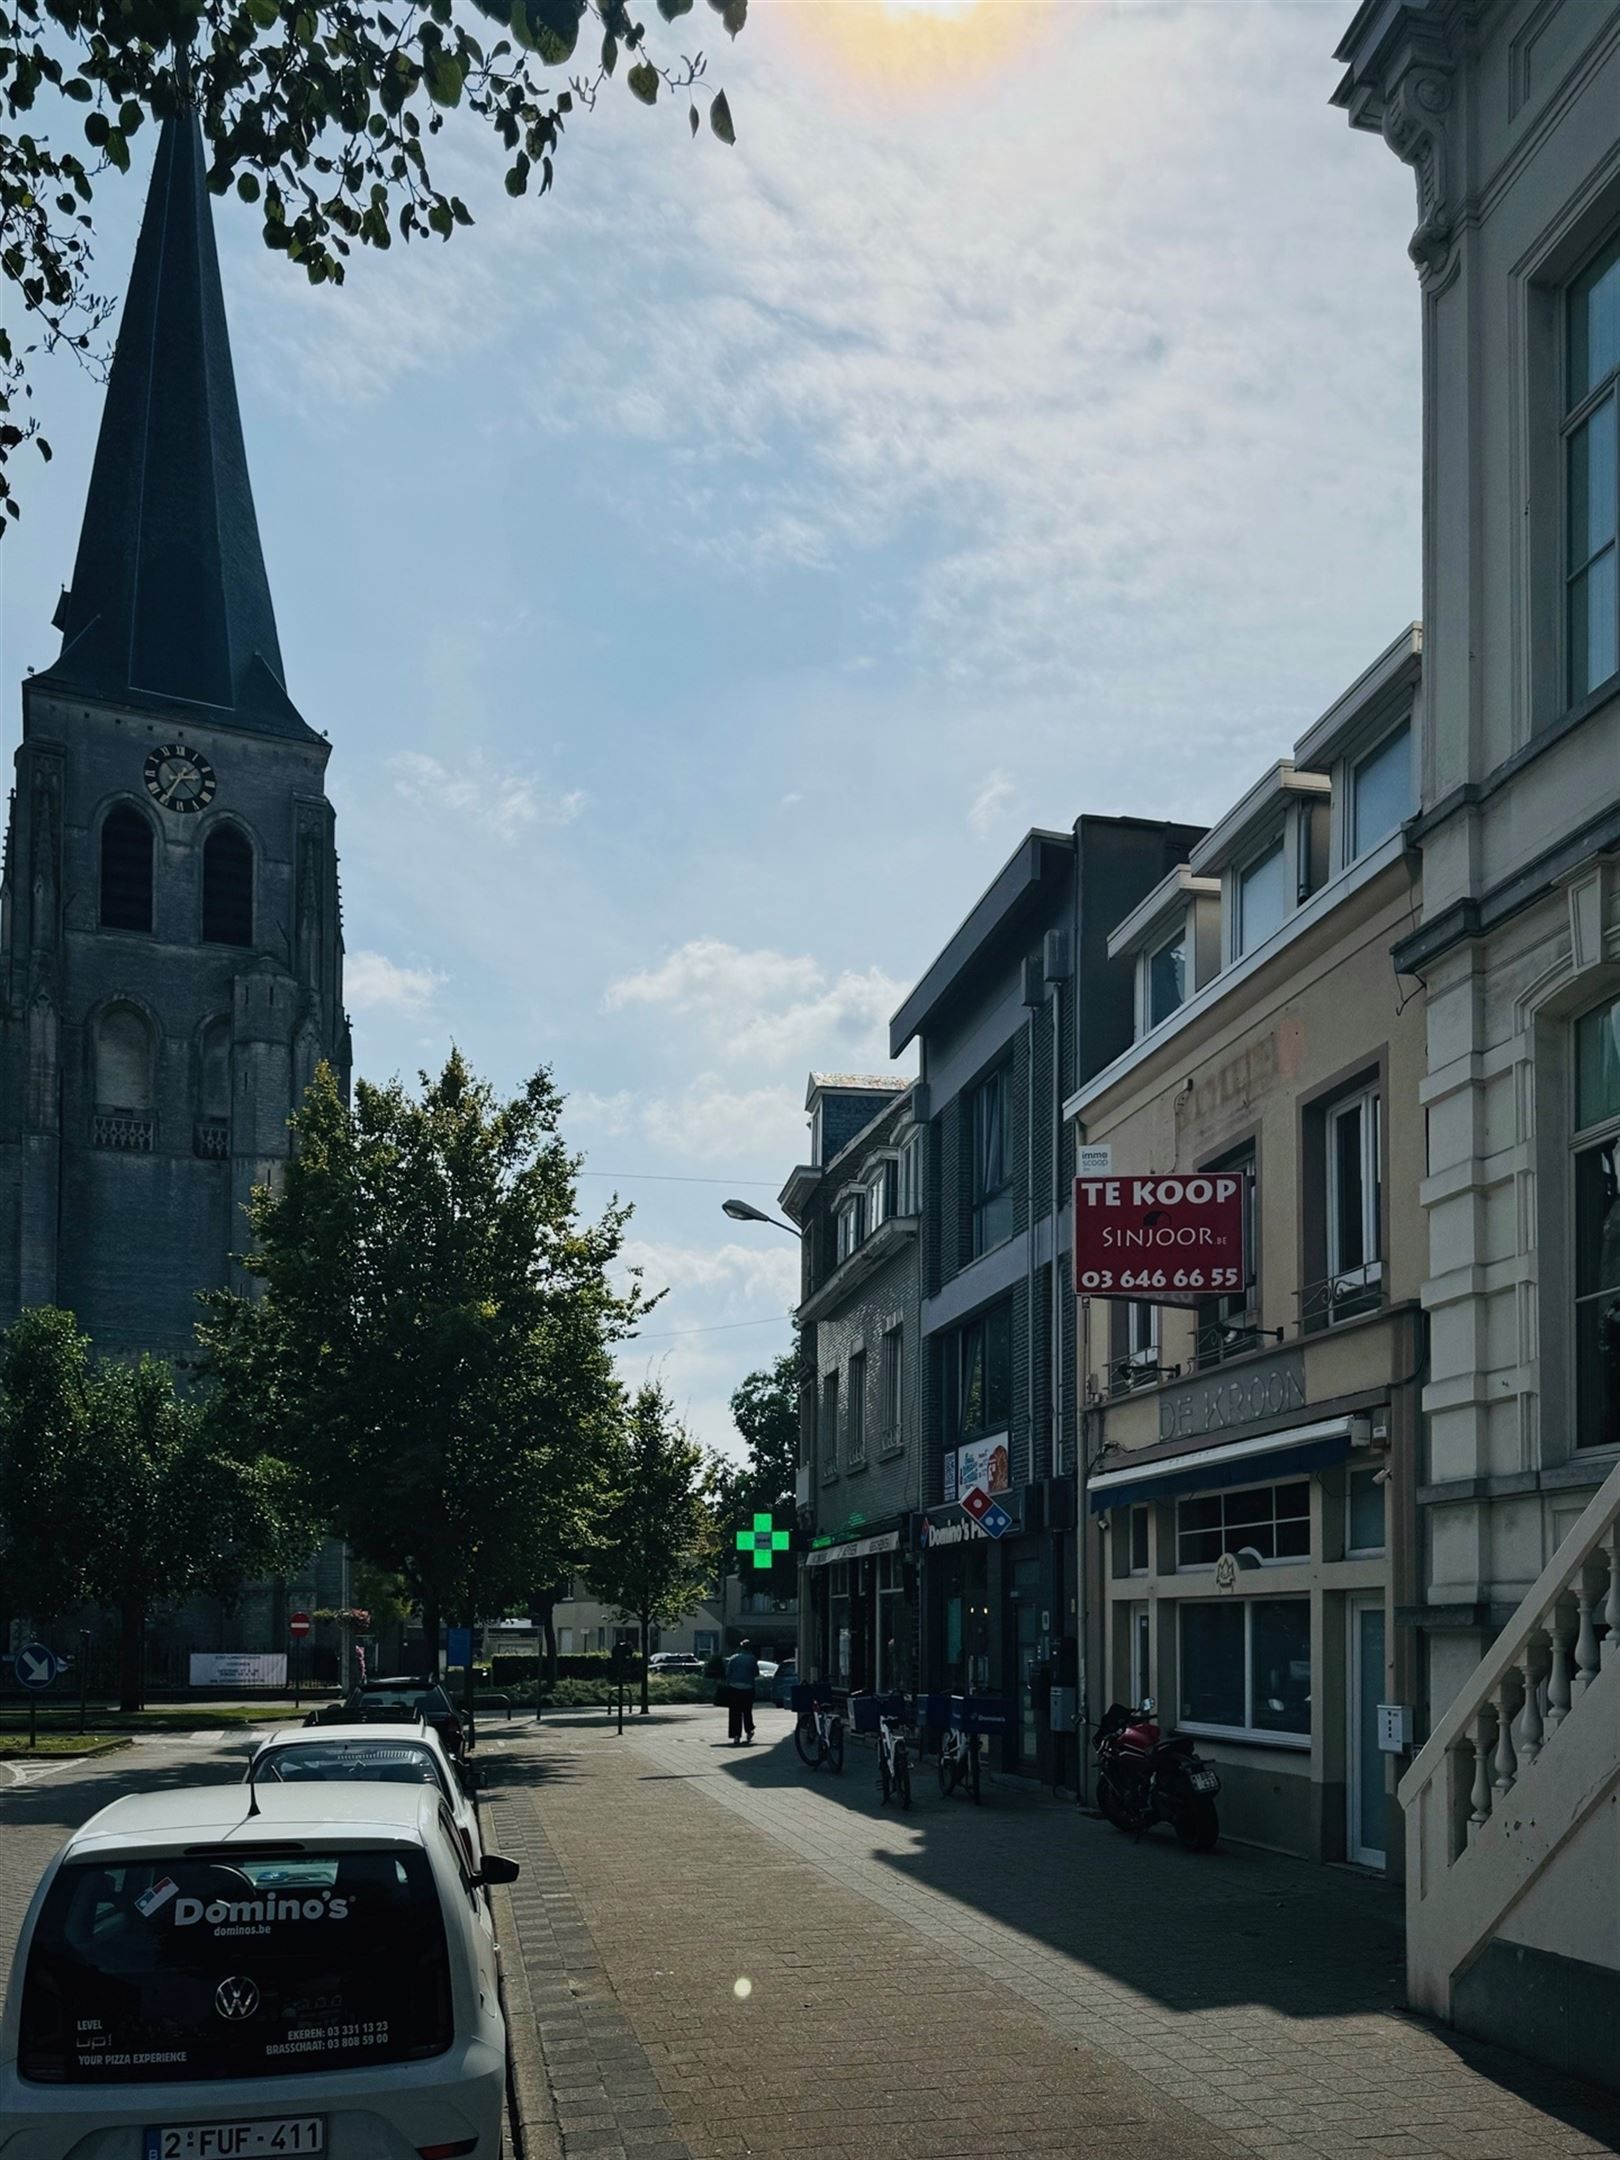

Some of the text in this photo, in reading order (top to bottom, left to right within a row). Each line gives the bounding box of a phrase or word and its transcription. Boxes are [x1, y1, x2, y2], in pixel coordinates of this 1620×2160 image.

[1082, 1151, 1108, 1160] immo
[1082, 1160, 1109, 1168] scoop
[1081, 1179, 1237, 1206] TE KOOP
[1081, 1268, 1238, 1288] 03 646 66 55
[1160, 1370, 1306, 1442] DE KROON
[929, 1517, 970, 1548] Domino's
[214, 1925, 271, 1936] dominos.be
[77, 2020, 102, 2031] LEVEL
[288, 2021, 389, 2041] EKEREN: 03 331 13 23
[266, 2034, 389, 2055] BRASSCHAAT: 03 808 59 00
[78, 2052, 187, 2066] YOUR PIZZA EXPERIENCE
